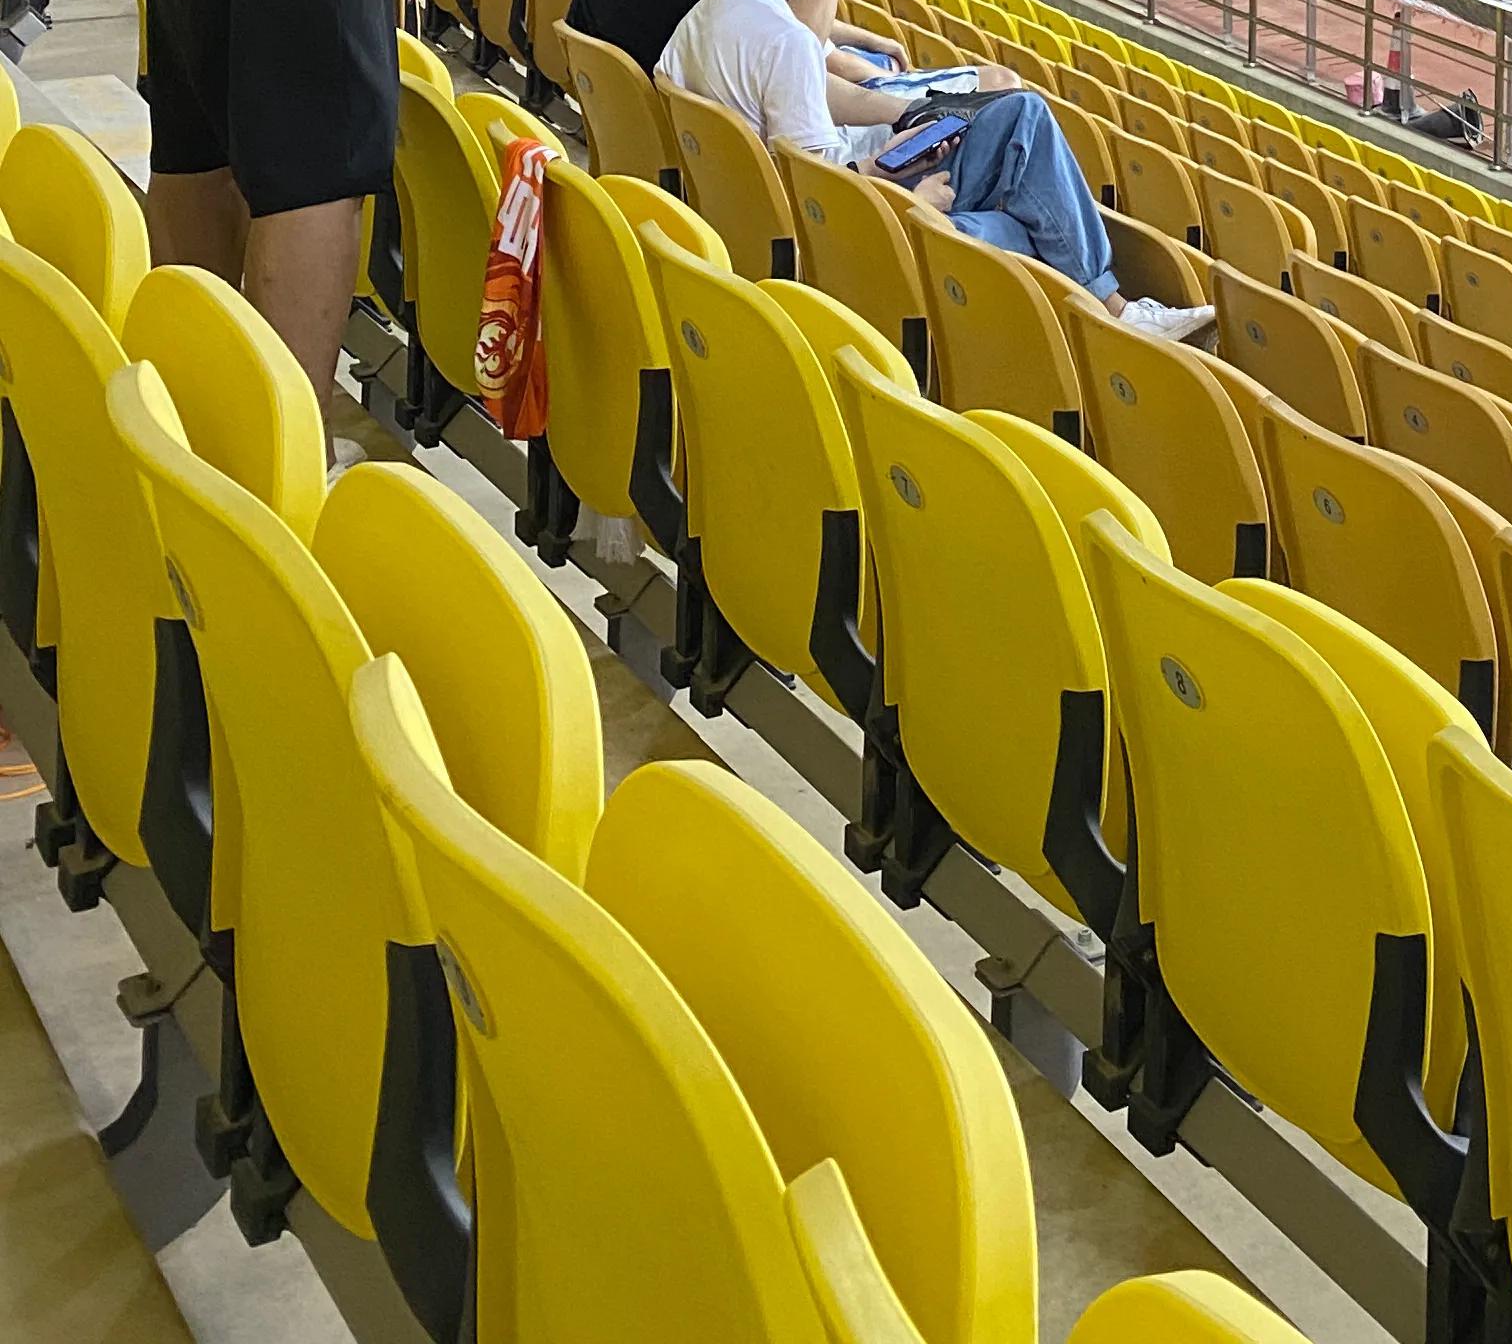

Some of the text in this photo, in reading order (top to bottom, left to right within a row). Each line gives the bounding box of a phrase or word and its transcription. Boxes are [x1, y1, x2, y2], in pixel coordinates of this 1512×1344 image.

[1118, 382, 1126, 397] 5
[900, 475, 909, 492] 7
[1323, 498, 1332, 514] 6
[1175, 671, 1187, 695] 8
